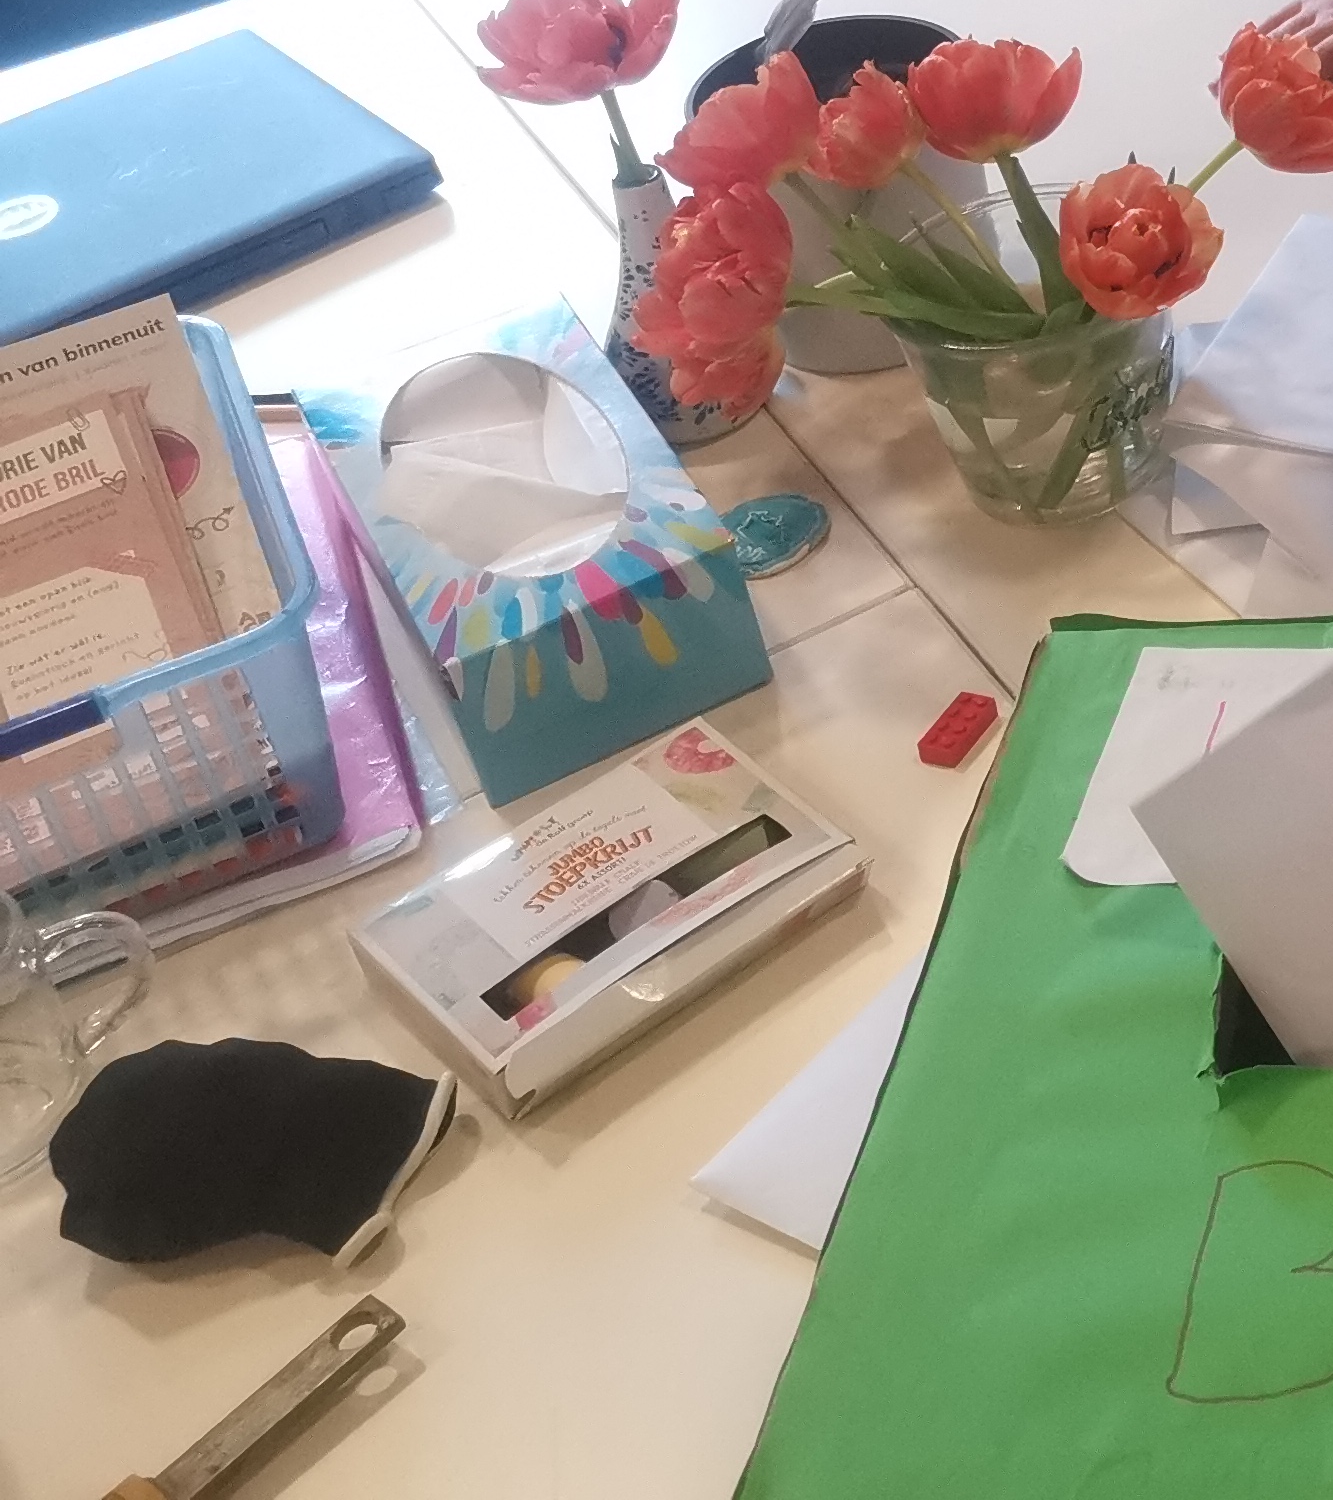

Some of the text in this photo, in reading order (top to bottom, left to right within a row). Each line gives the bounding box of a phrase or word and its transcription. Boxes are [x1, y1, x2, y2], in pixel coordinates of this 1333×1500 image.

[18, 353, 60, 376] van
[62, 318, 166, 363] binnenuit
[39, 432, 88, 464] VAN
[53, 459, 107, 493] BRIL
[523, 825, 655, 914] STOEPKRIJT
[546, 836, 605, 878] JUMBO
